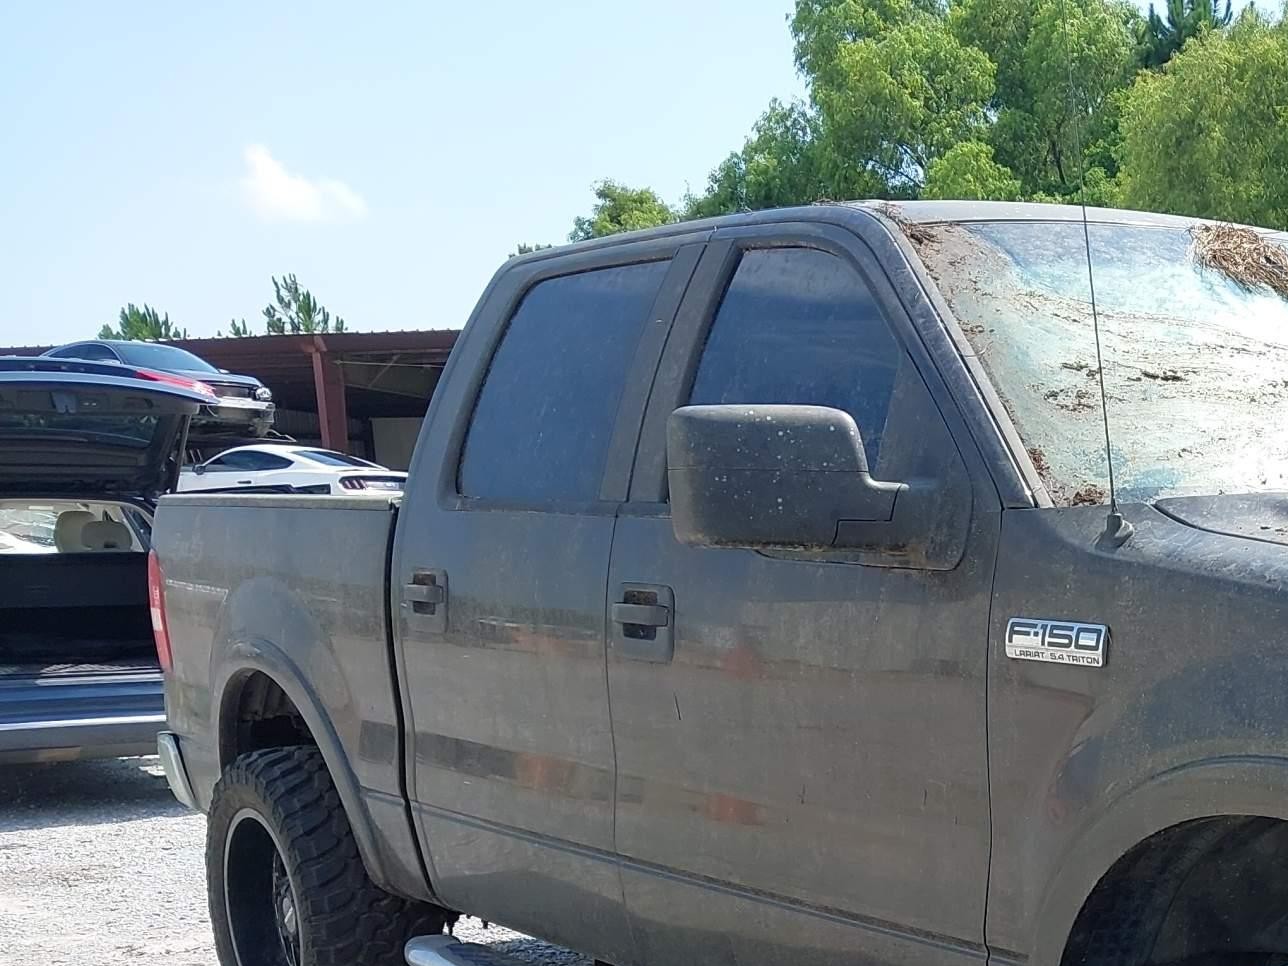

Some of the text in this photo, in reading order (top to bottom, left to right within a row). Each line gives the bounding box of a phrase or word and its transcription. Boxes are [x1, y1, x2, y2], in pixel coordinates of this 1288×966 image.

[1008, 621, 1103, 651] F-150
[1014, 649, 1045, 659] LARIAT
[1066, 655, 1100, 665] TRITON
